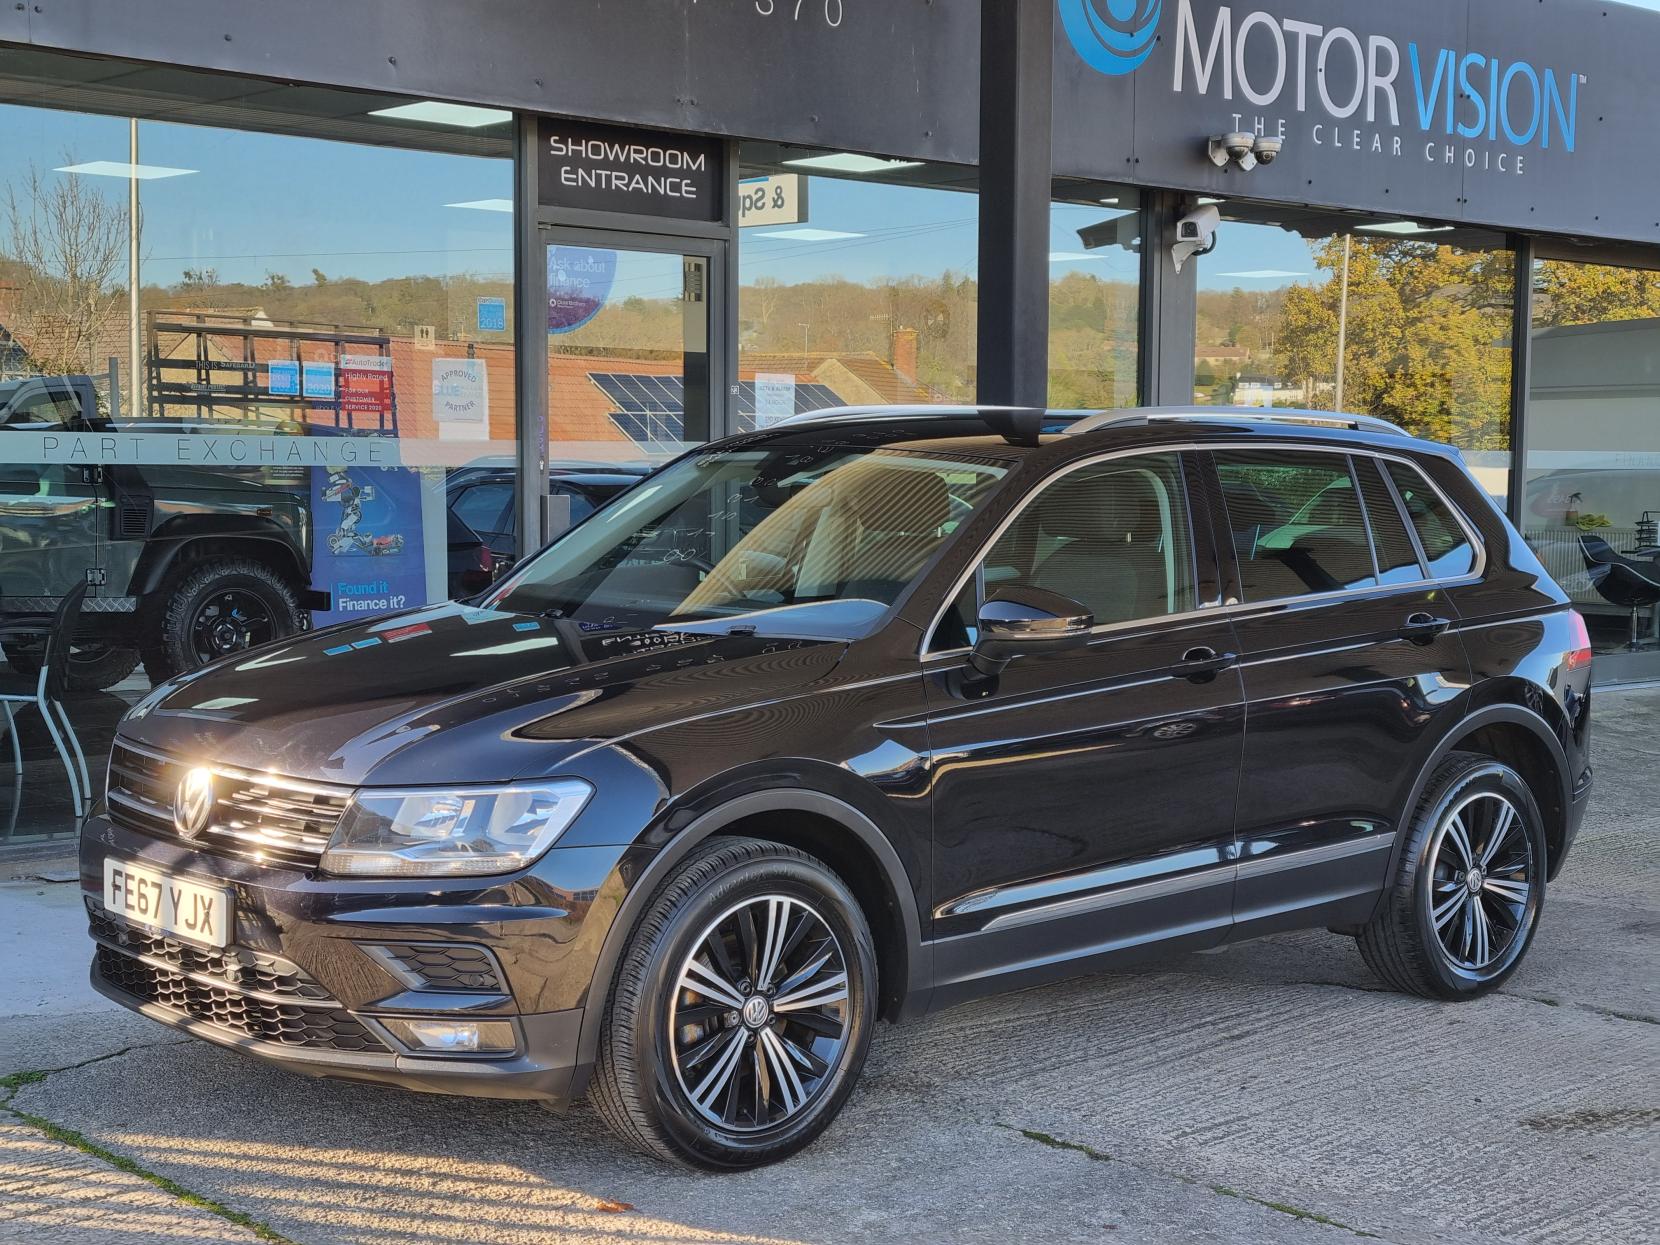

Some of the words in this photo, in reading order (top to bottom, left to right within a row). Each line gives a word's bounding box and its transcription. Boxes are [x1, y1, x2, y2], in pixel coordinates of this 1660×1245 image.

[1173, 0, 1400, 126] MOTOR
[1408, 42, 1578, 153] VISION
[1232, 113, 1286, 140] THE
[1313, 124, 1401, 156] CLEAR
[1426, 142, 1524, 174] CHOICE
[550, 136, 705, 172] SHOWROOM
[560, 166, 697, 198] ENTRANCE
[550, 256, 571, 271] Ask
[574, 259, 605, 273] about
[550, 272, 590, 288] finance
[211, 361, 218, 370] IS
[345, 373, 365, 382] Highly
[367, 373, 388, 381] Rated
[441, 370, 477, 383] APPROVED
[445, 400, 476, 412] PARTNER
[43, 436, 144, 460] PART
[177, 438, 383, 462] EXCHANGE
[338, 580, 377, 595] Found
[379, 580, 389, 594] it
[339, 598, 387, 612] Finance
[389, 595, 406, 609] it?
[112, 868, 163, 920] FE67
[169, 886, 213, 936] YJX
